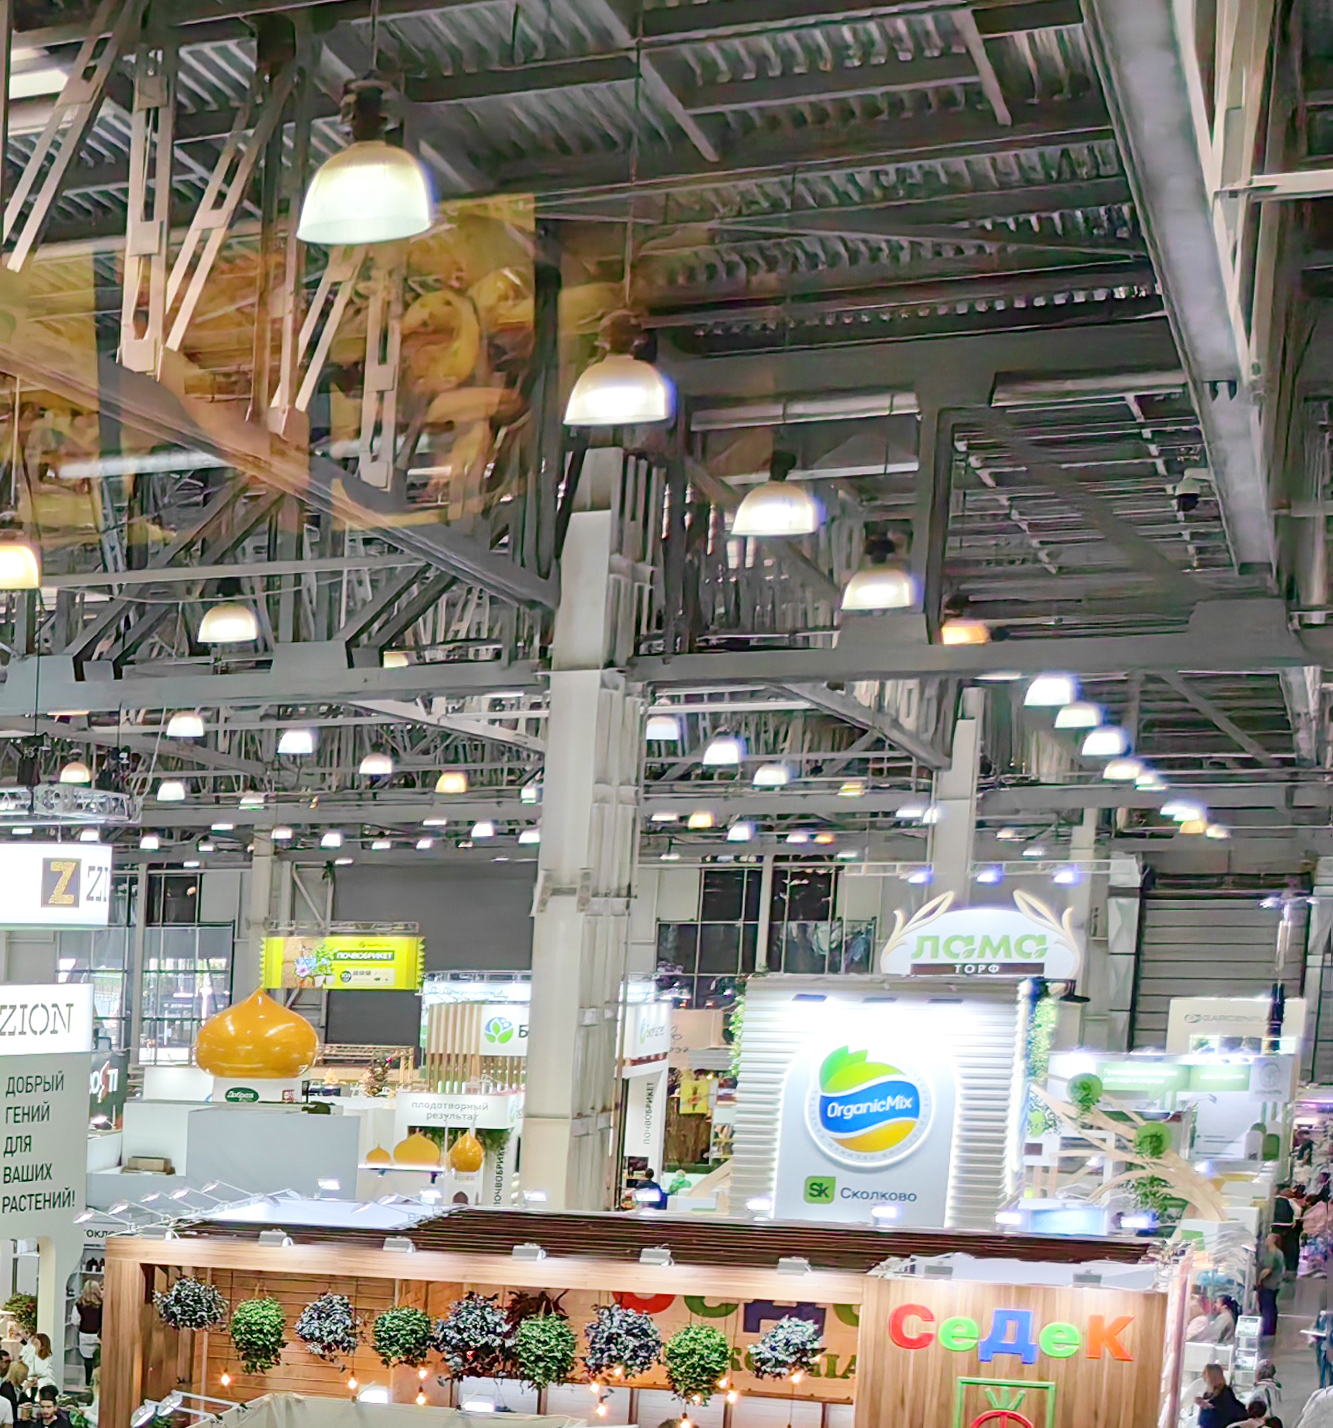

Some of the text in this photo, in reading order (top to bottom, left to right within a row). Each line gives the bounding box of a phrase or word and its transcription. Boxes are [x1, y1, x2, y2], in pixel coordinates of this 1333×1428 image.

[86, 865, 111, 903] ZI
[954, 964, 1000, 974] ТОРФ
[5, 1070, 65, 1098] ДОБРЫЙ
[6, 1101, 50, 1125] ГЕНИЙ
[411, 1100, 489, 1111] плодотворный
[426, 1111, 479, 1122] результат
[826, 1094, 915, 1120] OrganicMix
[3, 1135, 32, 1158] ДЛЯ
[3, 1163, 53, 1184] ВАШИХ
[2, 1187, 75, 1214] РАСТЕНИЙ!
[808, 1182, 830, 1199] Sk
[840, 1187, 918, 1202] Сколково
